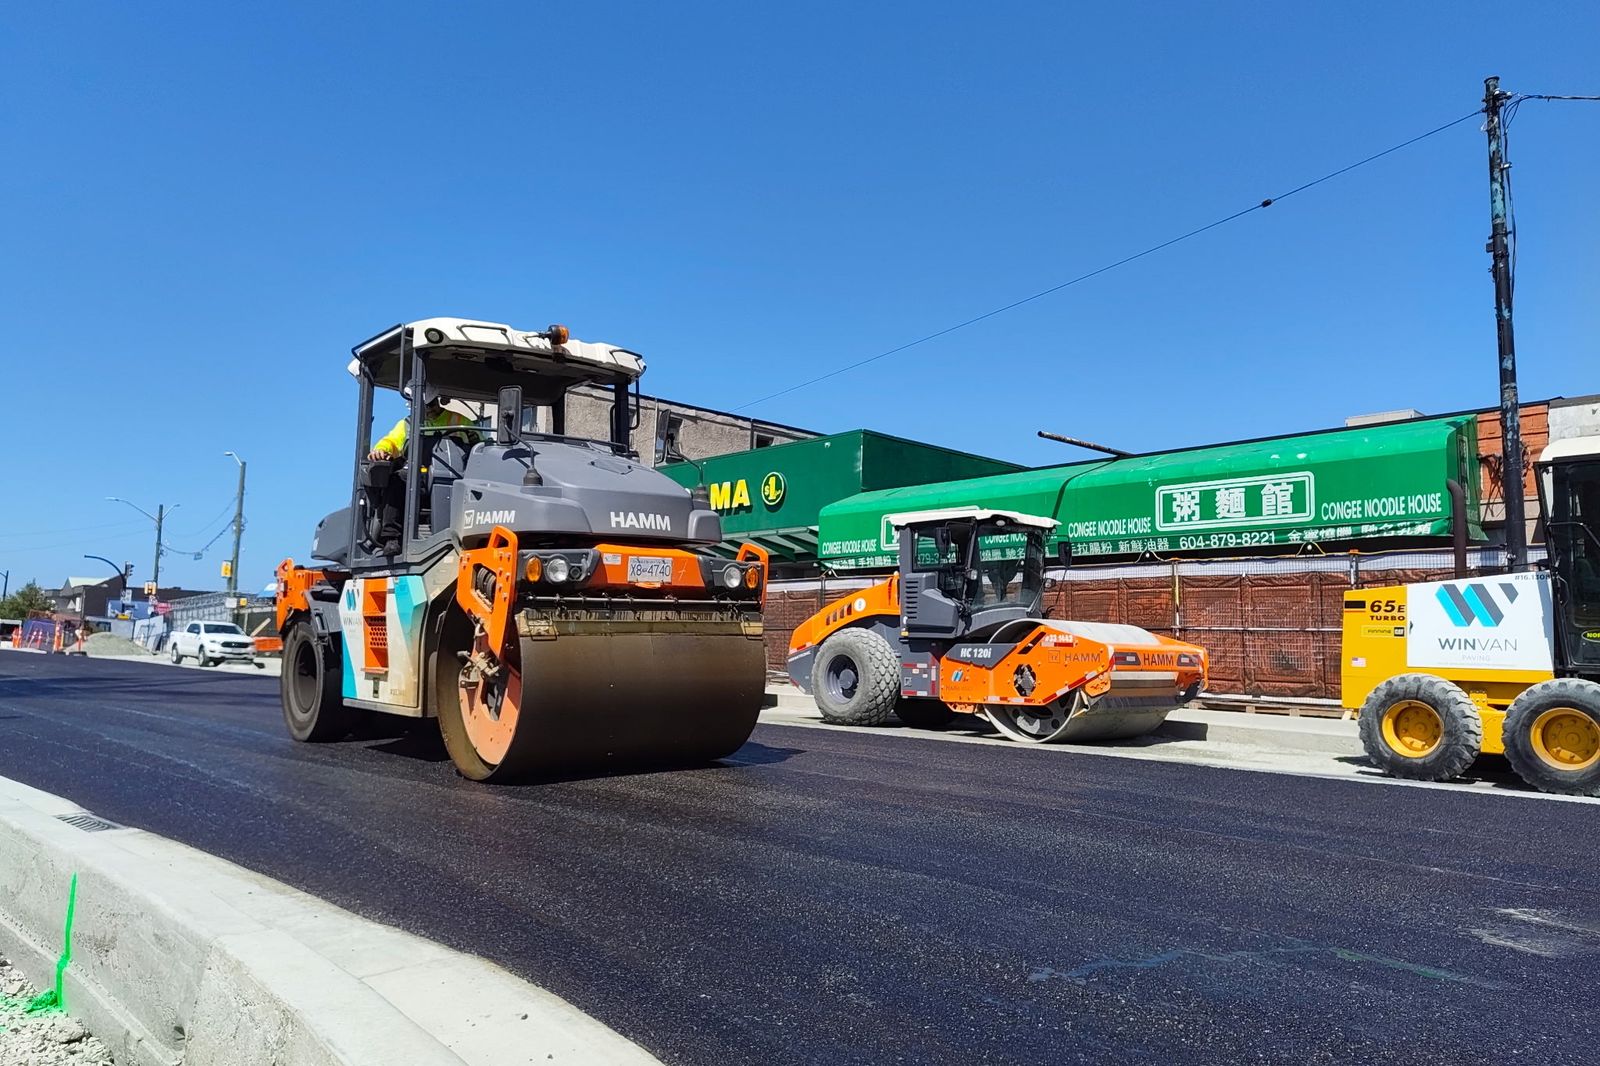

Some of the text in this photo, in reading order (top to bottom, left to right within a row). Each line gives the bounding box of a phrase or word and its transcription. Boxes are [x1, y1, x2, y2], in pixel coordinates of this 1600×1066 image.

[1321, 493, 1442, 521] CONGEE NOODLE HOUSE
[476, 510, 516, 525] HAMM
[610, 511, 671, 531] HAMM
[1068, 517, 1152, 538] CONGEE NOODLE HOUSE
[822, 539, 877, 554] CONGEE NOODLE HOUSE
[1179, 531, 1275, 549] 604-879-8221
[1438, 638, 1518, 651] WINVAN
[973, 647, 992, 658] 120i
[1064, 652, 1100, 663] HAMM
[1143, 653, 1174, 666] HAMM
